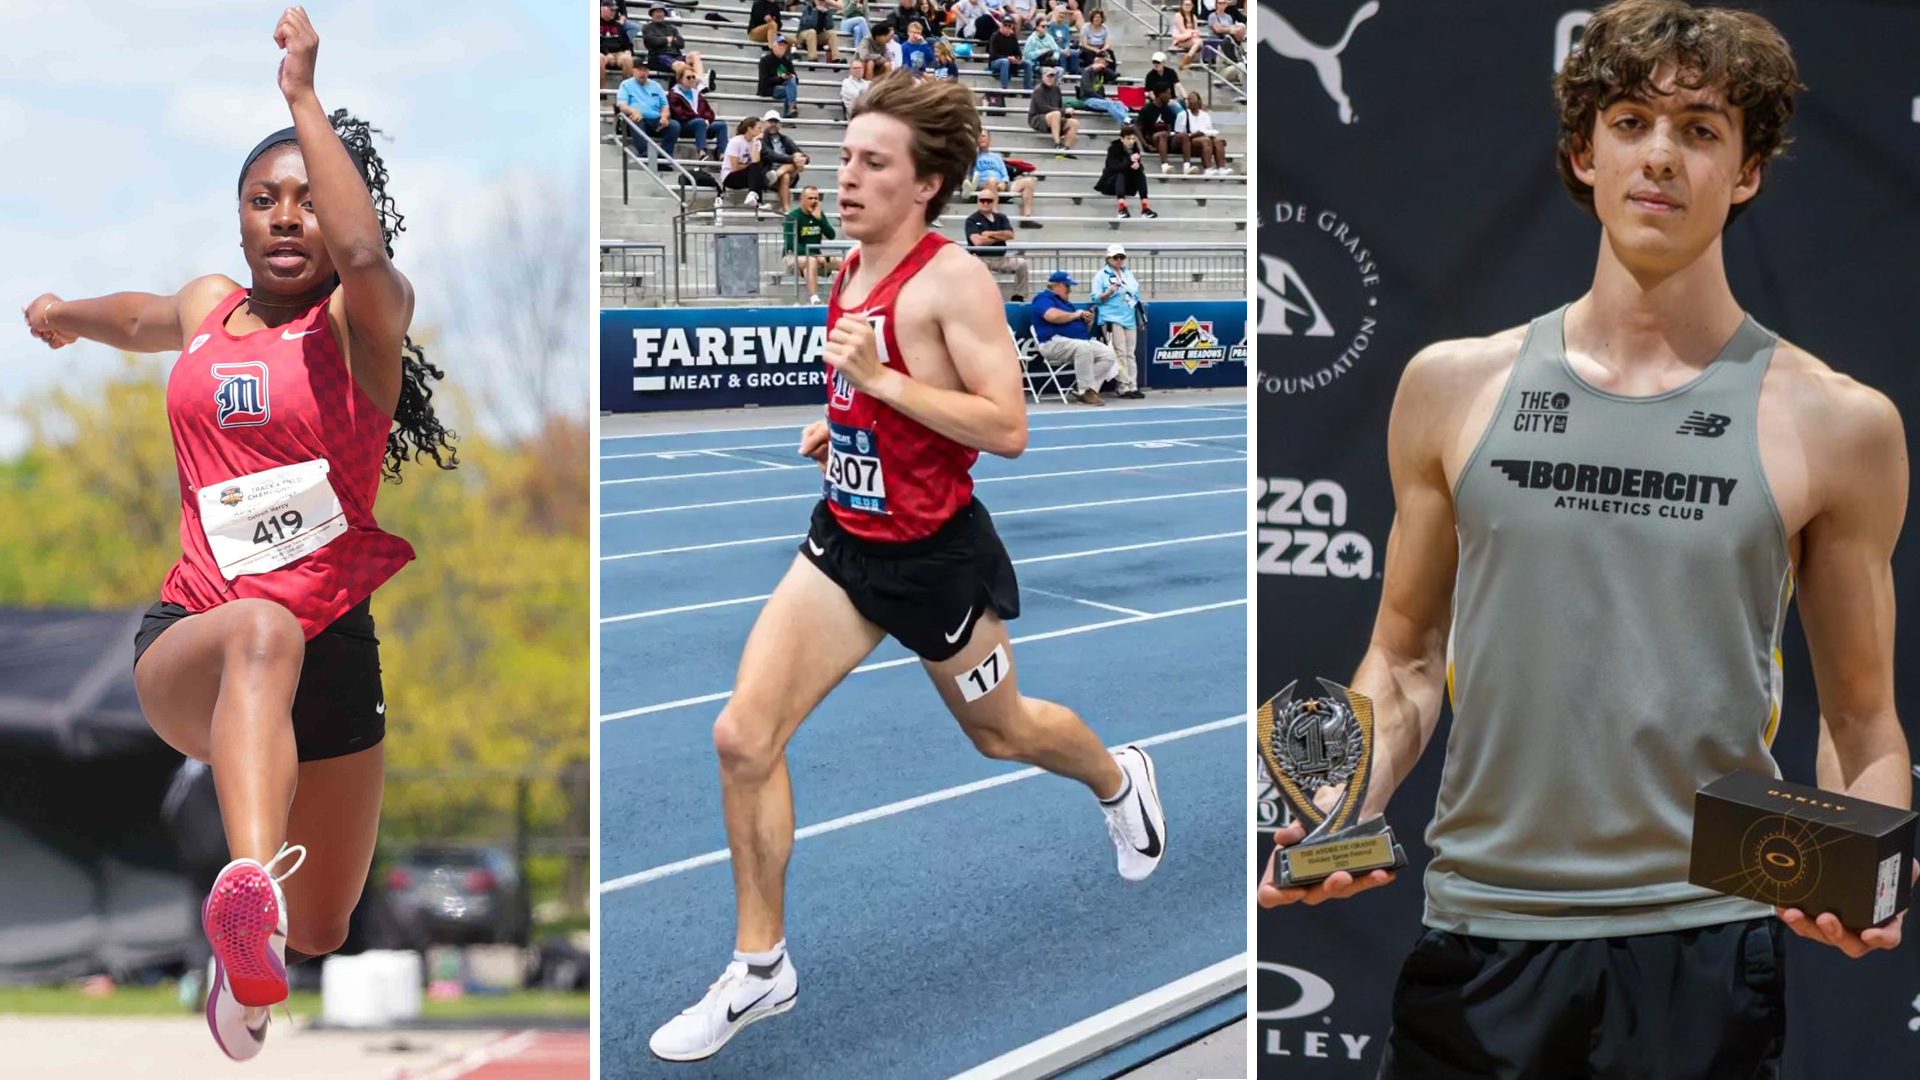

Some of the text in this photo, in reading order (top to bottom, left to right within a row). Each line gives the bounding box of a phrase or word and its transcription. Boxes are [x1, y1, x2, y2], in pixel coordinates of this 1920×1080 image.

[1275, 201, 1308, 223] DE
[1317, 210, 1381, 287] GRASSE
[1186, 349, 1223, 360] MEADOWS
[1257, 316, 1377, 395] FOUNDATION
[669, 370, 829, 390] MEAT & GROCERY
[1520, 391, 1552, 410] THE
[1513, 413, 1555, 434] CITY
[1529, 459, 1739, 507] BORDERCITY
[1554, 495, 1705, 521] ATHLETICS CLUB
[252, 509, 304, 545] 419
[968, 651, 1000, 694] 17
[1294, 713, 1332, 774] 1
[1266, 1028, 1372, 1061] LEY
